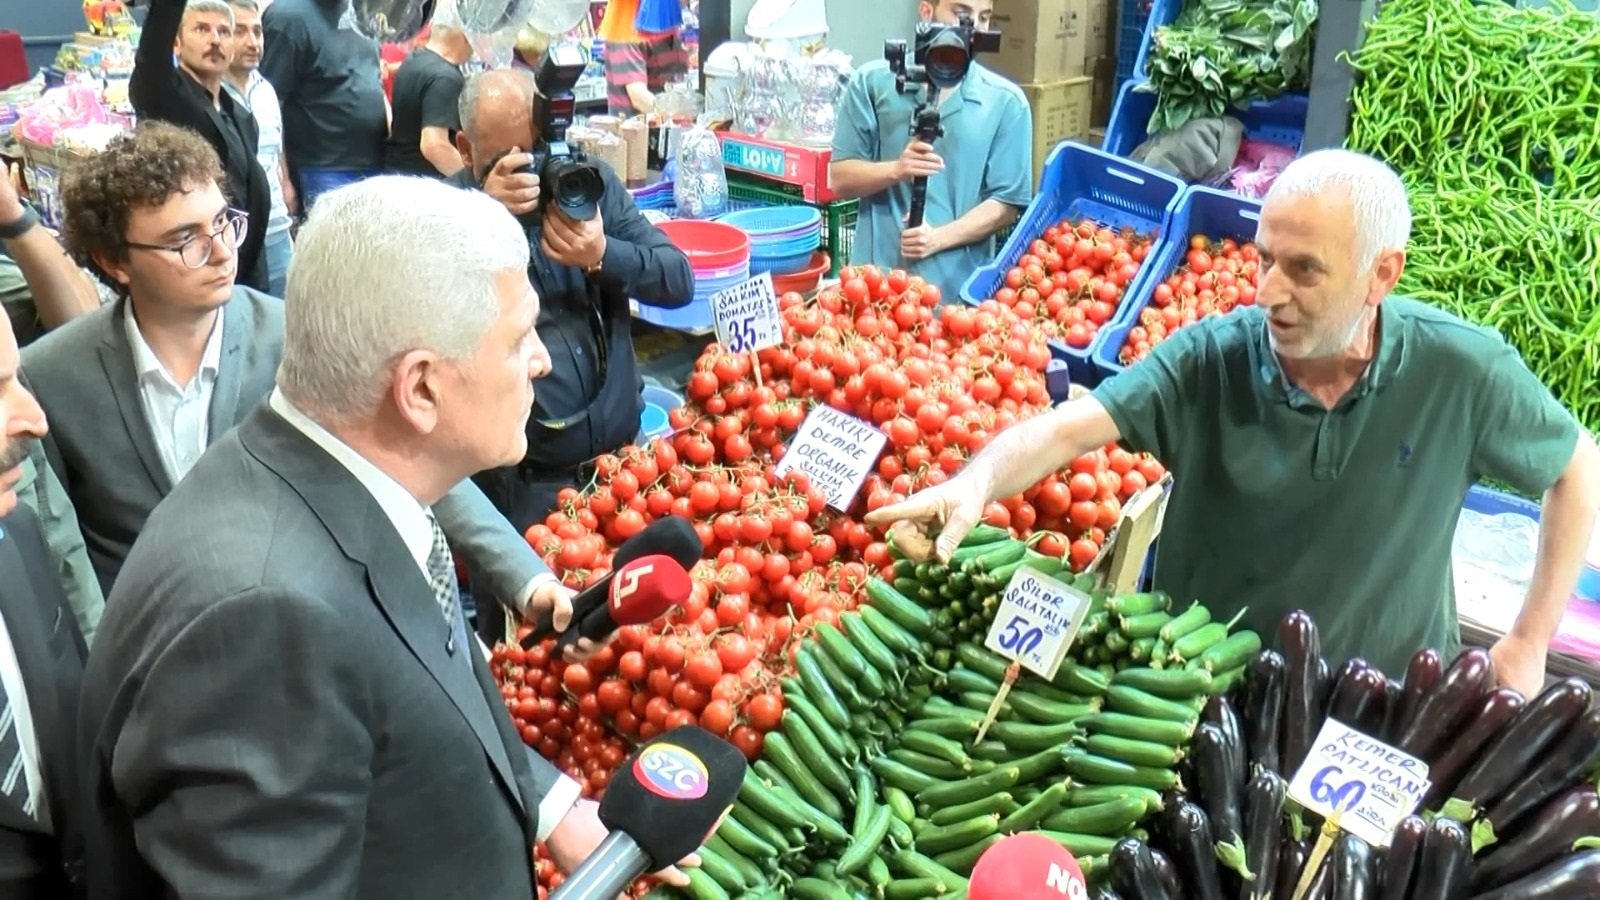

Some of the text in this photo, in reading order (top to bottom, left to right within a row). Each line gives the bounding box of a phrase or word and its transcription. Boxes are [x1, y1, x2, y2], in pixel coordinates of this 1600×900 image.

[729, 316, 756, 354] 35
[811, 427, 867, 460] DEMRE
[998, 615, 1043, 656] 50
[644, 750, 701, 792] SZC
[1336, 731, 1419, 778] KEMER
[1310, 765, 1367, 812] 60
